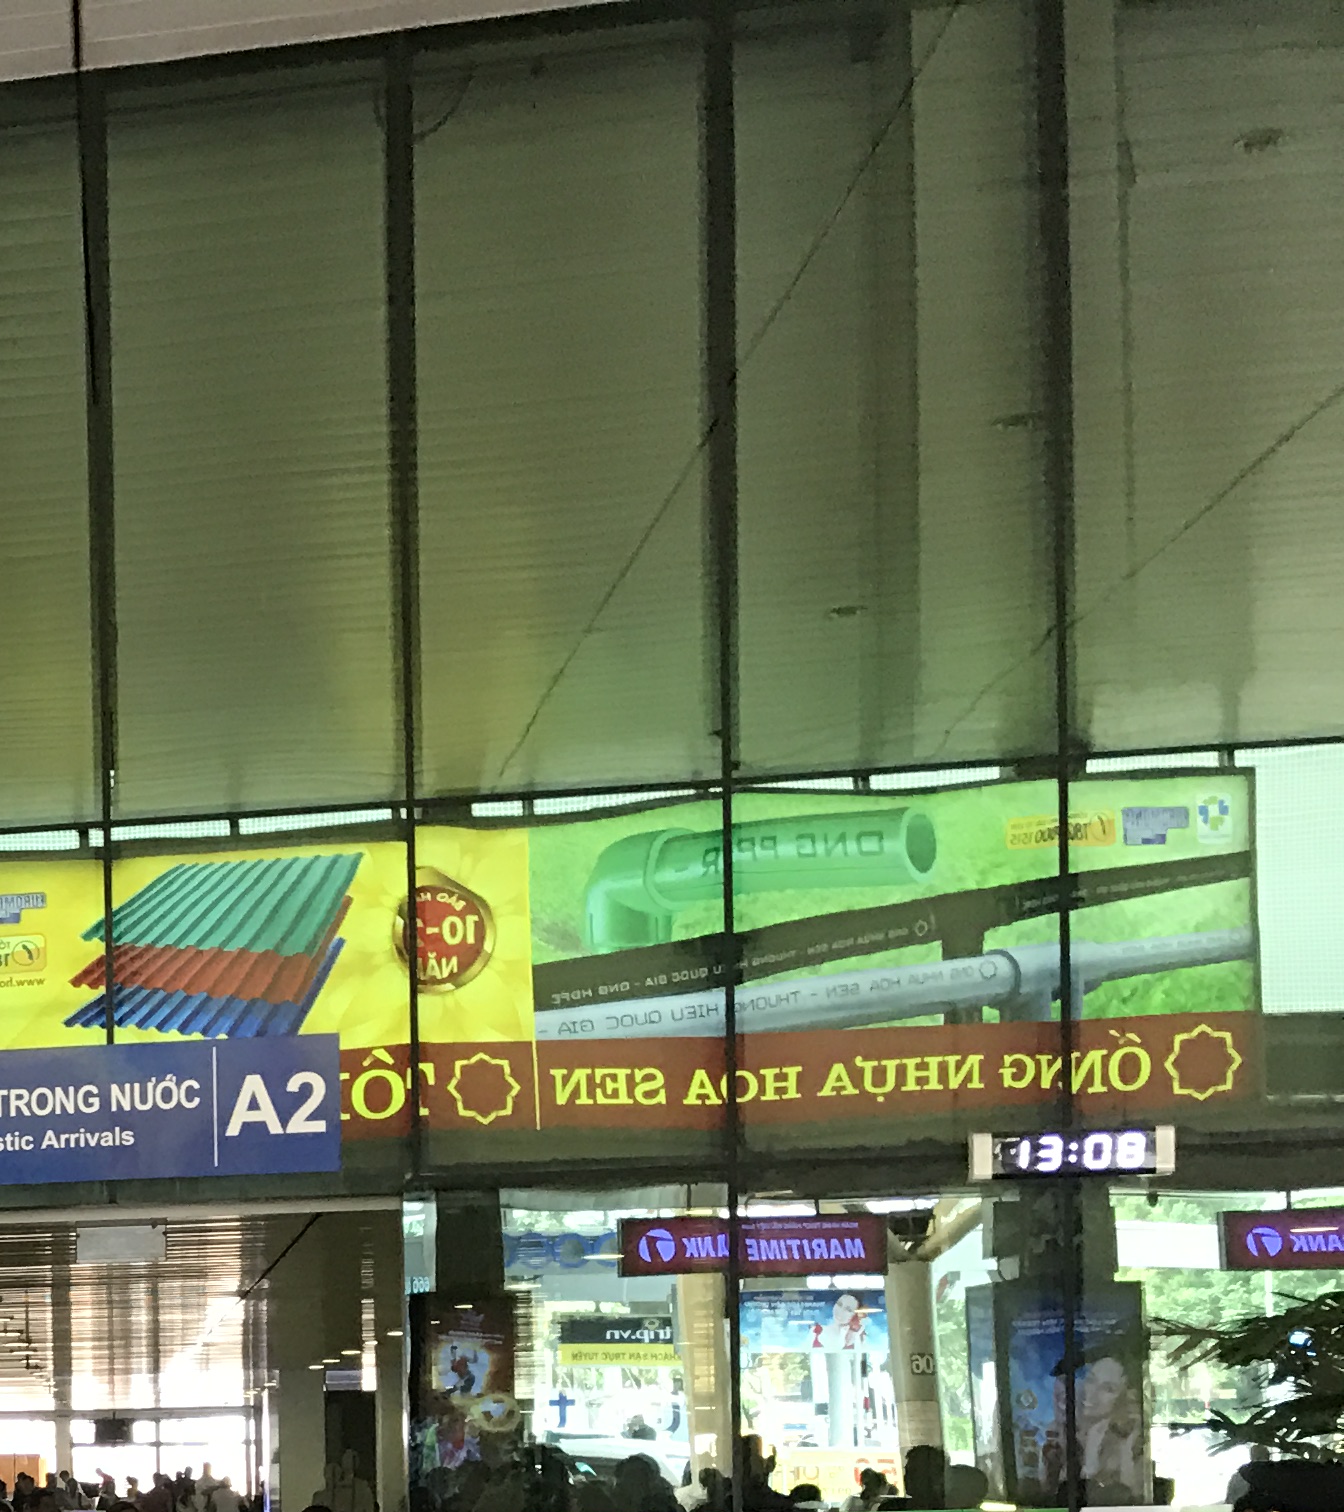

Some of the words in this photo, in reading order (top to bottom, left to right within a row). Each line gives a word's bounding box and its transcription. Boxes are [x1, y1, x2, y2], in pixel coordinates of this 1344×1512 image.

[109, 1072, 201, 1113] NƯỚC
[225, 1071, 328, 1138] A2
[41, 1125, 135, 1151] Arrivals
[1017, 1130, 1146, 1173] 13:08
